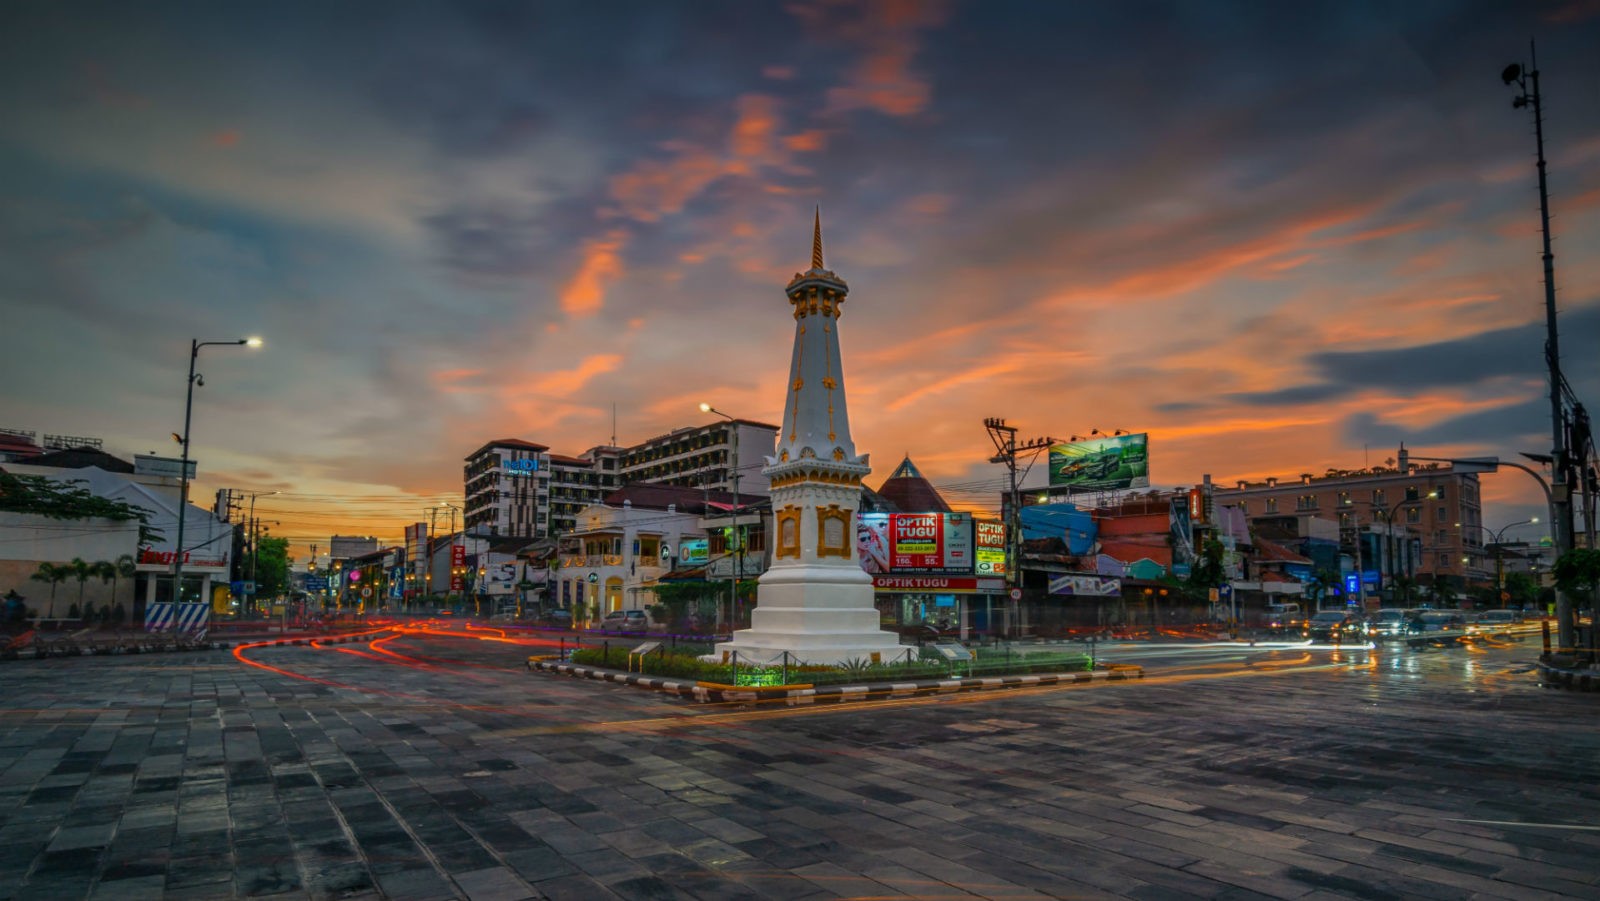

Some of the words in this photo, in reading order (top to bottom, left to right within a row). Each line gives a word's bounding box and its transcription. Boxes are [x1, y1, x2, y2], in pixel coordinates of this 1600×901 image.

[519, 458, 539, 471] 101
[897, 517, 935, 527] OPTIK
[897, 527, 935, 537] TUGU
[978, 522, 1003, 534] OPTIK
[978, 533, 1004, 545] TUGU
[877, 578, 914, 587] OPTIK
[914, 578, 949, 588] TUGU
